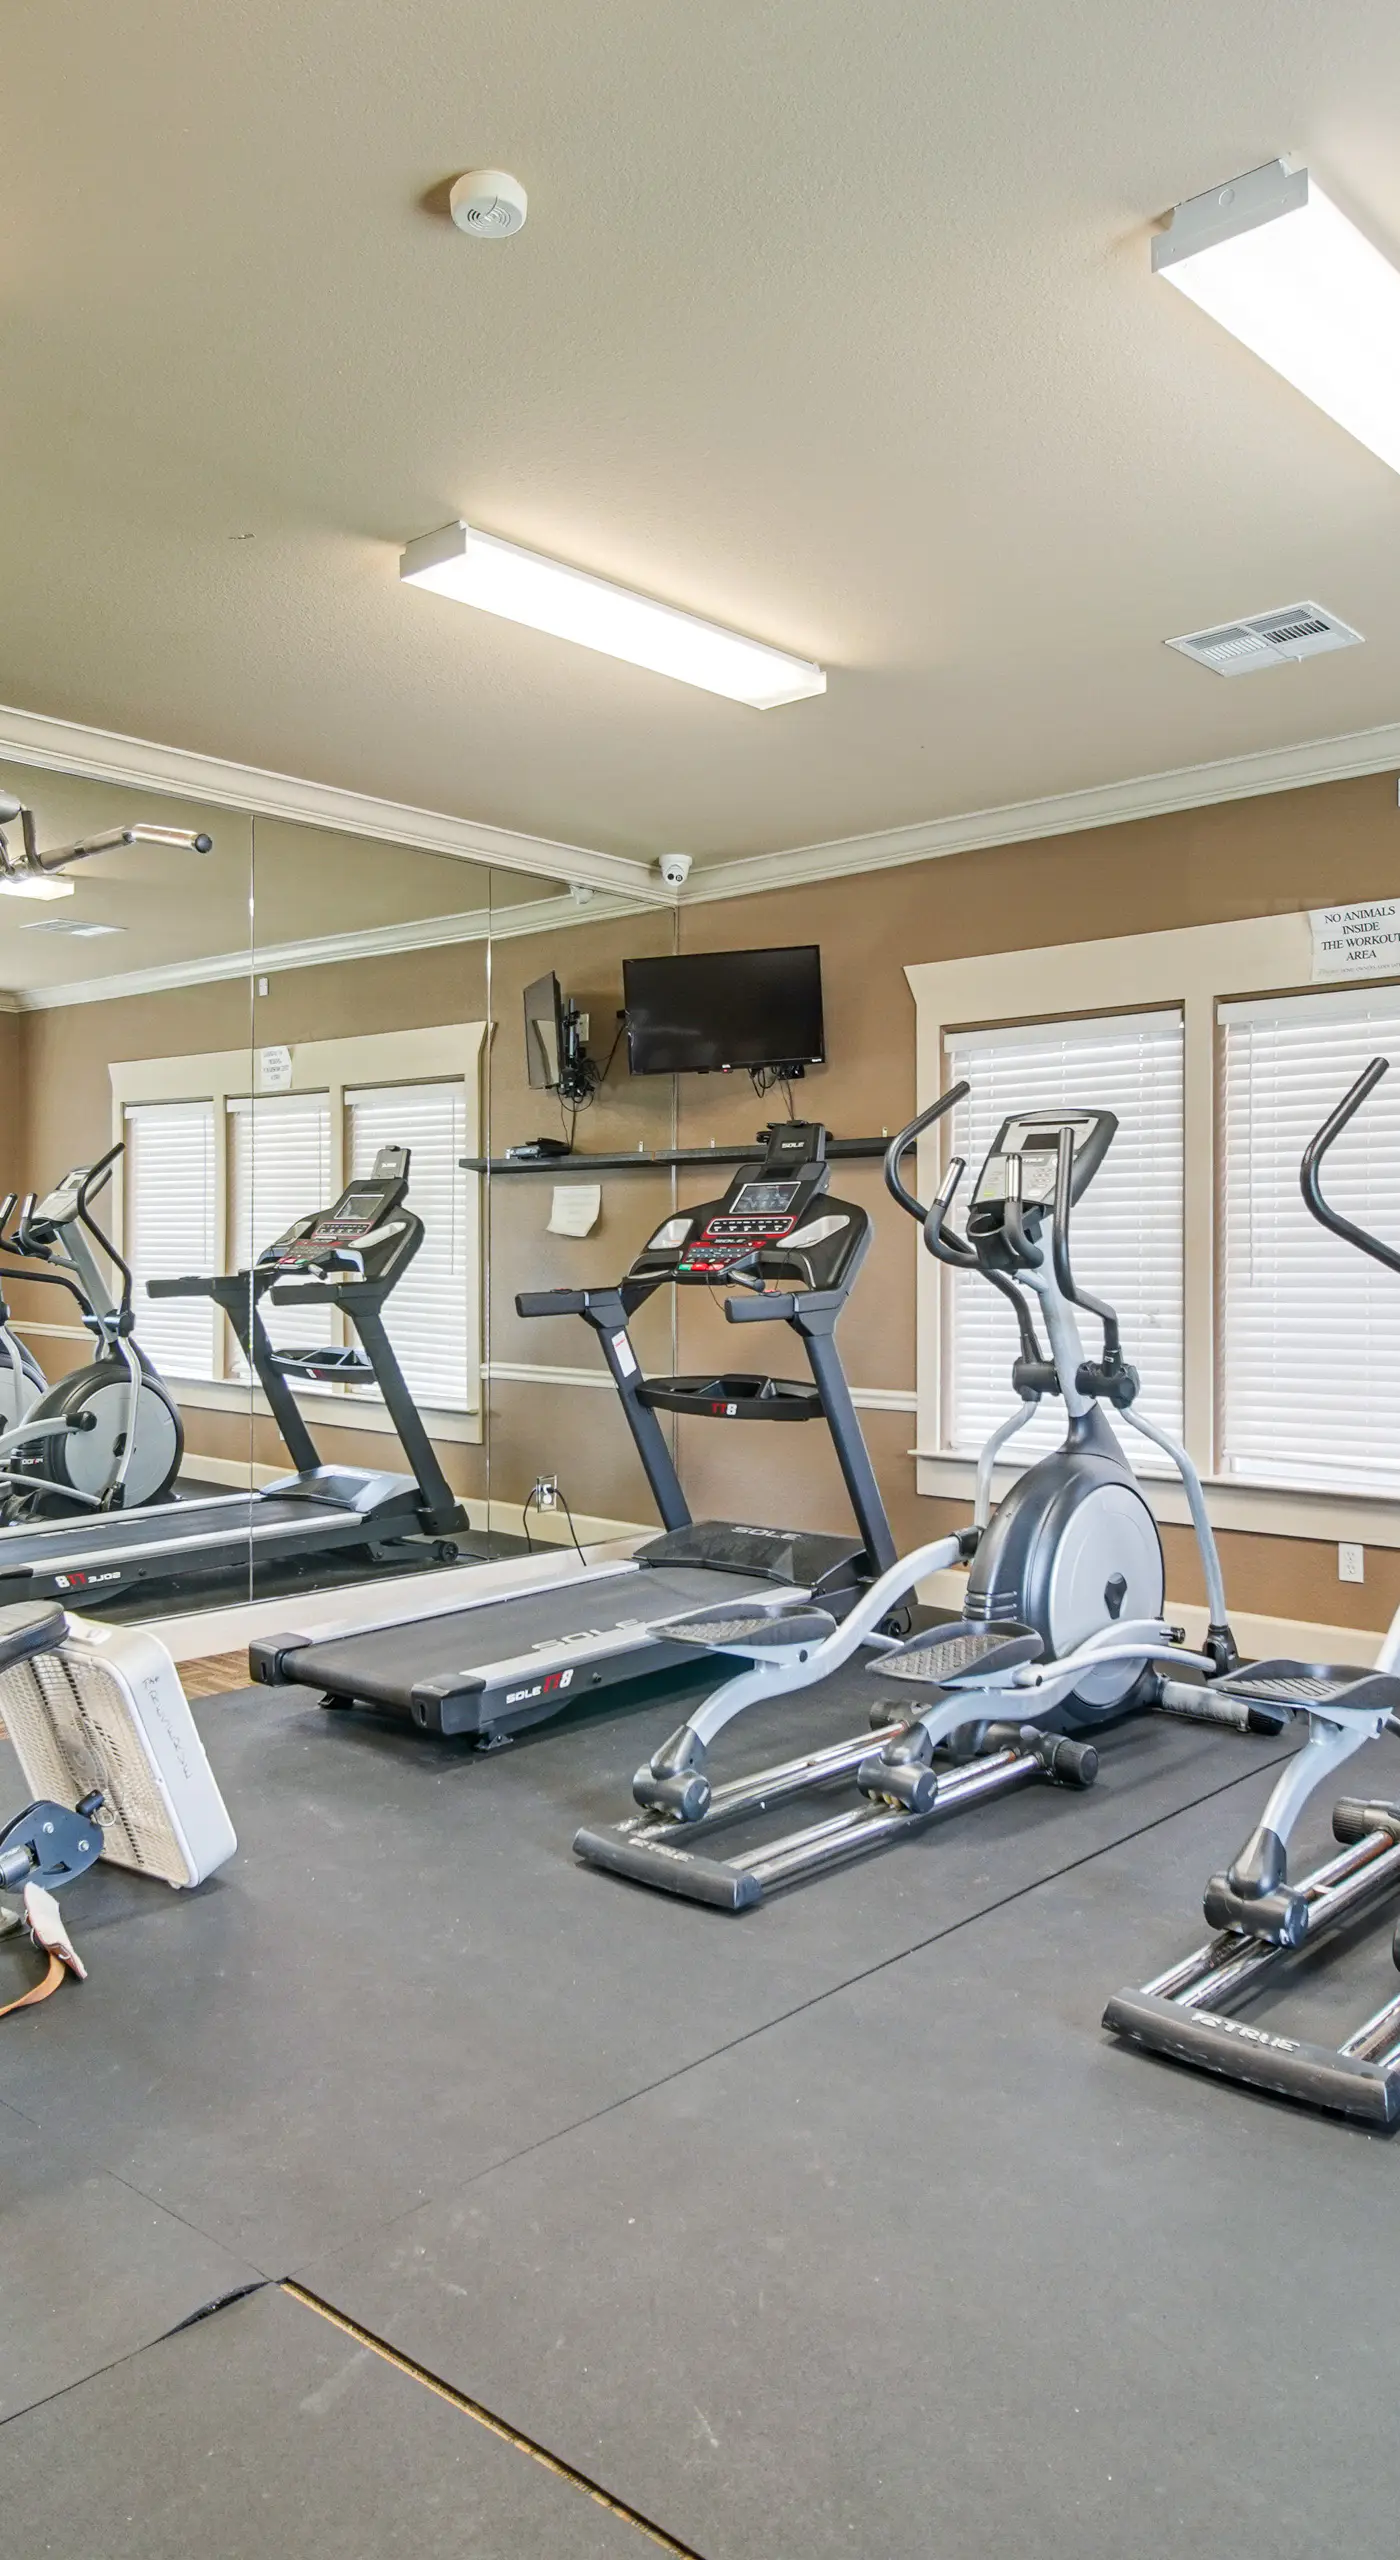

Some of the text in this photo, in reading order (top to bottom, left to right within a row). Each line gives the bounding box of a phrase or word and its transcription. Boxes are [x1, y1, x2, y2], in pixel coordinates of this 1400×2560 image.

[1324, 906, 1396, 924] NO ANIMALS
[1342, 922, 1380, 935] INSIDE
[1321, 933, 1400, 951] THE WORKOUT
[1346, 950, 1377, 961] AREA
[781, 1141, 805, 1149] SOLE
[711, 1402, 738, 1416] TT8
[731, 1526, 803, 1541] SOLE
[505, 1669, 574, 1705] SOLE TT8
[1223, 2019, 1301, 2053] TRUE
